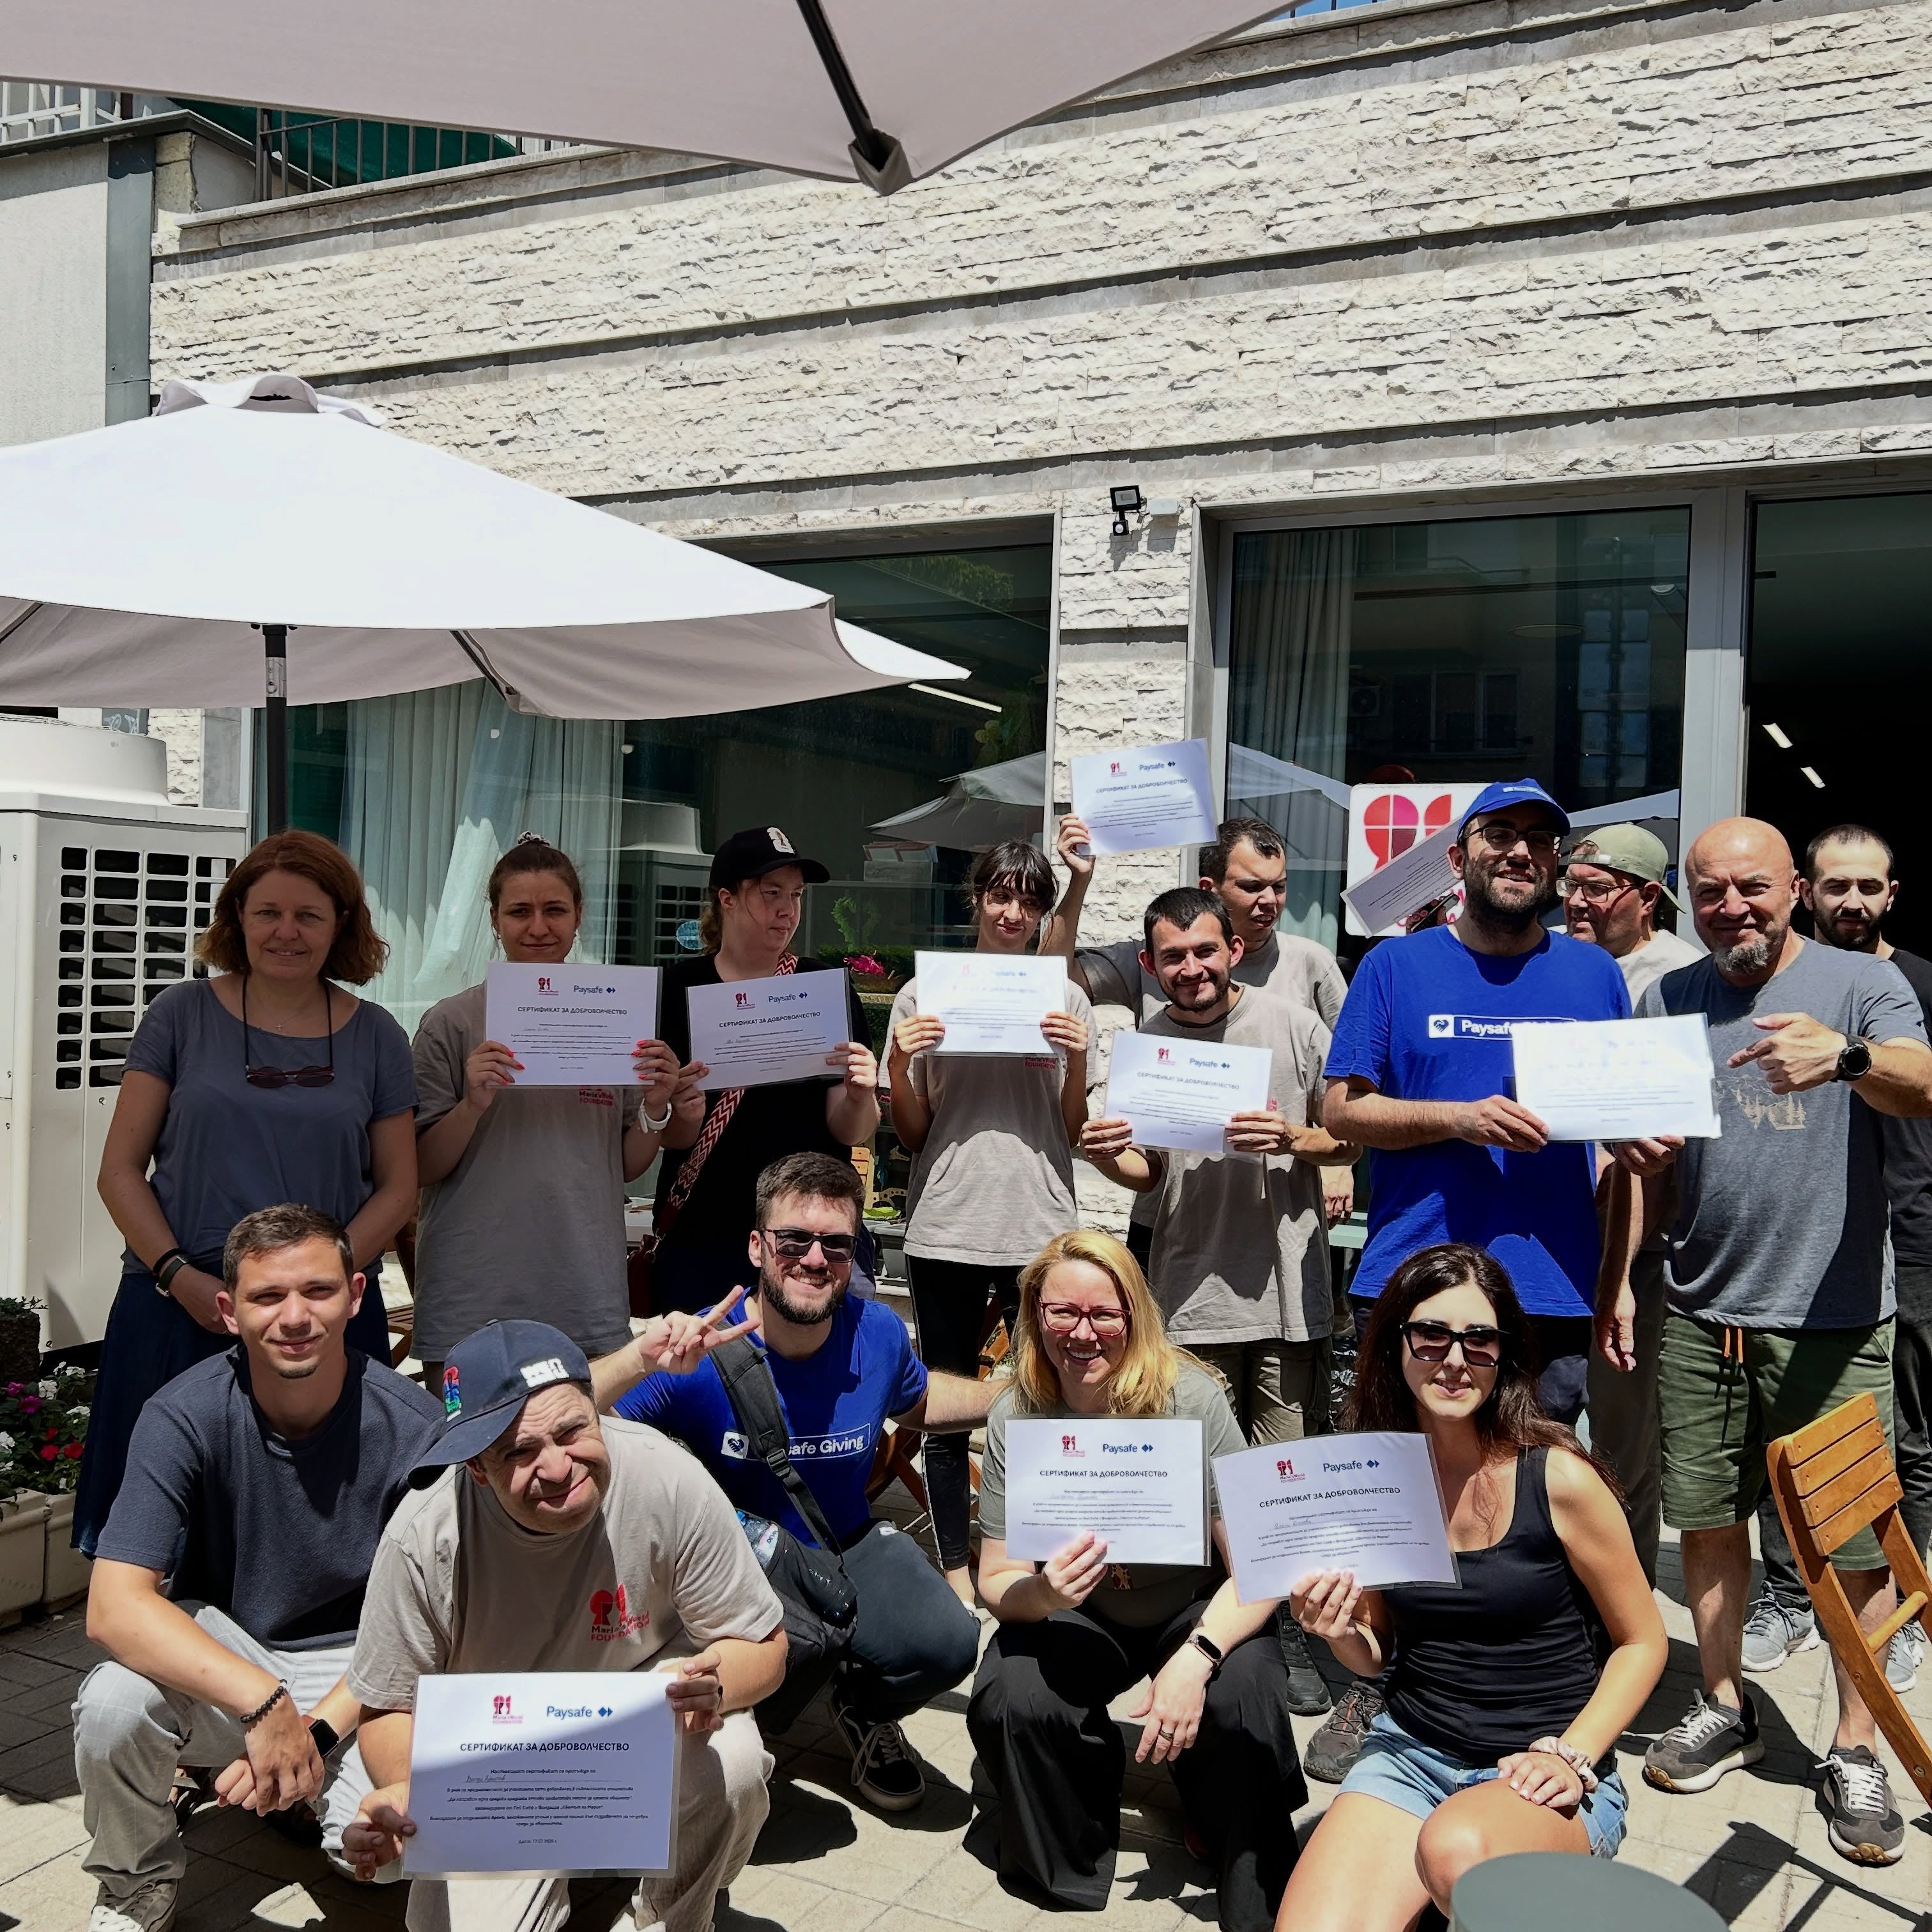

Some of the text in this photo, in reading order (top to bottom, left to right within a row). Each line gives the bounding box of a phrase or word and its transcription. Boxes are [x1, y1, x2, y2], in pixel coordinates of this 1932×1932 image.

[1139, 763, 1165, 771] Paysafe
[574, 985, 603, 994] Paysafe
[769, 993, 796, 1004] Paysafe
[719, 1018, 758, 1028] СЕРТИФИКАТ
[1461, 1019, 1512, 1037] Paysaf
[1190, 1058, 1218, 1068] Paysafe
[820, 1435, 864, 1453] Giving
[1103, 1444, 1138, 1453] Paysafe
[1323, 1460, 1362, 1473] Paysafe
[1259, 1494, 1312, 1508] СЕРТИФИКАТ
[1324, 1487, 1400, 1499] ДОБРОВОЛЧЕСТВО
[546, 1706, 592, 1721] Paysafe
[460, 1742, 629, 1752] СЕРТИФИКАТ ЗА ДОБРОВОЛЧЕСТВО
